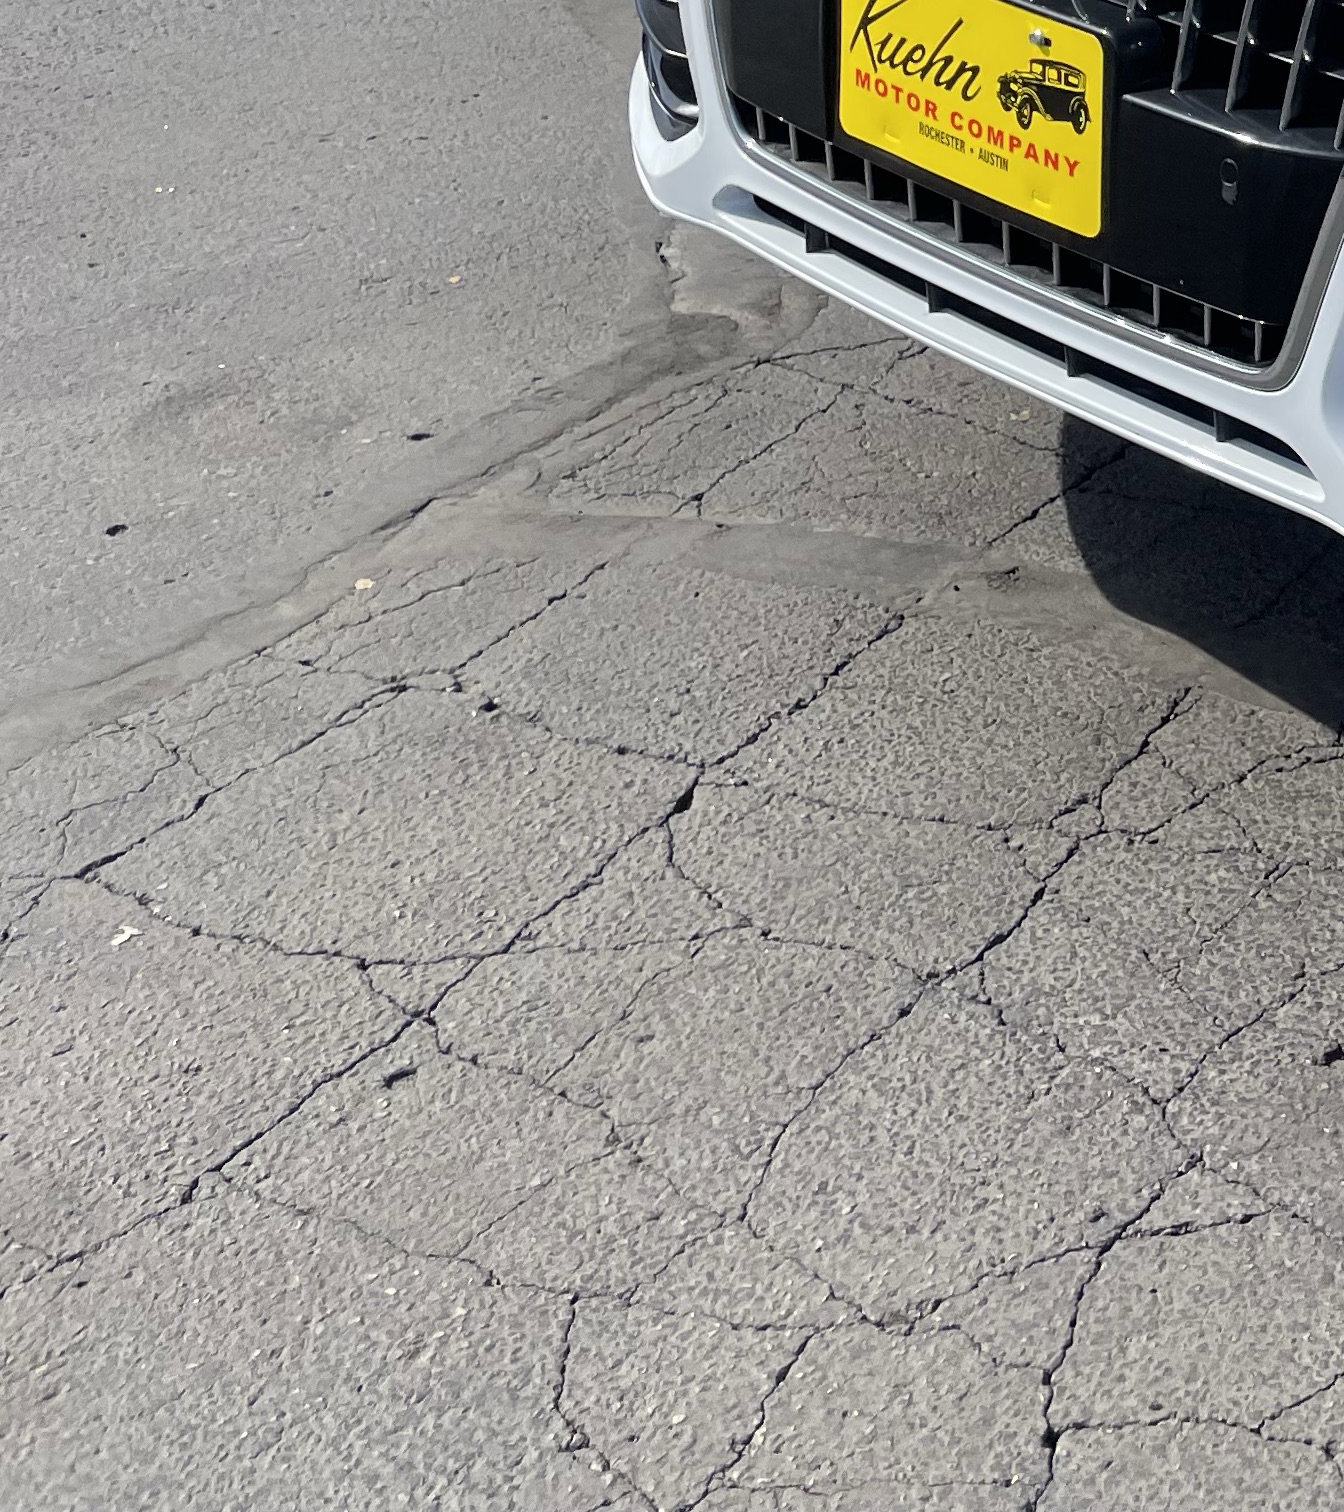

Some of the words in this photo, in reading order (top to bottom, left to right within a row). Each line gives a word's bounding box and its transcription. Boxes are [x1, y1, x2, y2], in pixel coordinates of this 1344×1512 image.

[856, 68, 939, 121] MOTOR
[950, 111, 1080, 178] COMPANY
[918, 121, 966, 154] ROCHESTER
[978, 147, 1009, 172] AUSTIN
